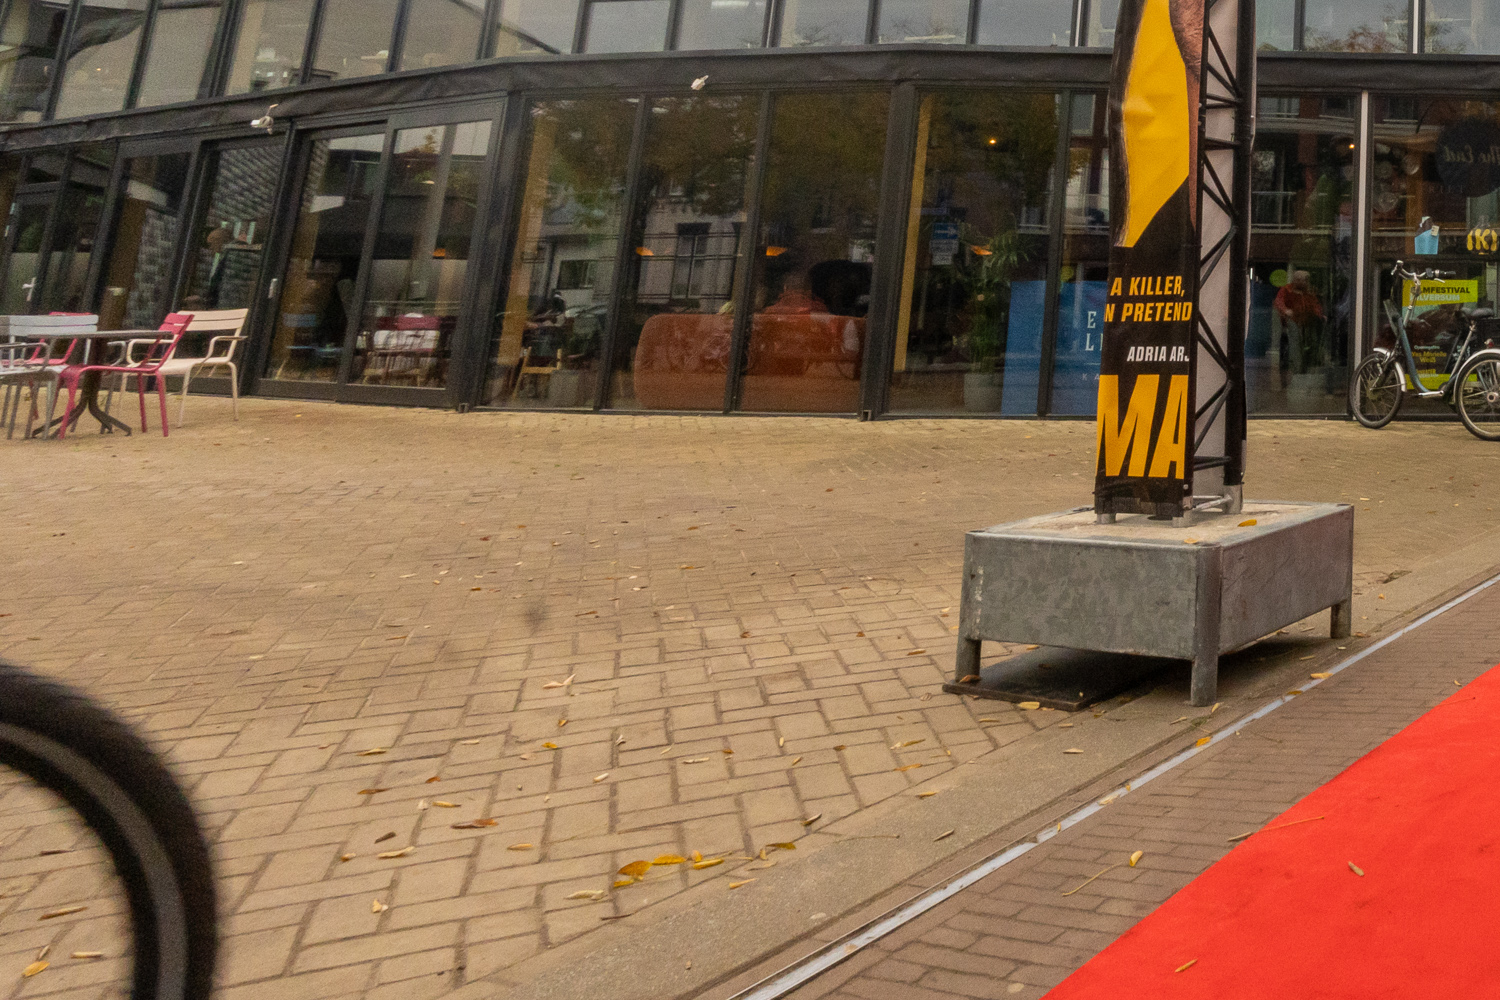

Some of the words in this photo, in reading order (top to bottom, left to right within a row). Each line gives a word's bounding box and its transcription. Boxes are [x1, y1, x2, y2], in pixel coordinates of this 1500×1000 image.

[1110, 277, 1122, 296] A
[1129, 276, 1185, 298] KILLER,
[1121, 302, 1192, 322] PRETEND
[1126, 346, 1167, 362] ADRIA
